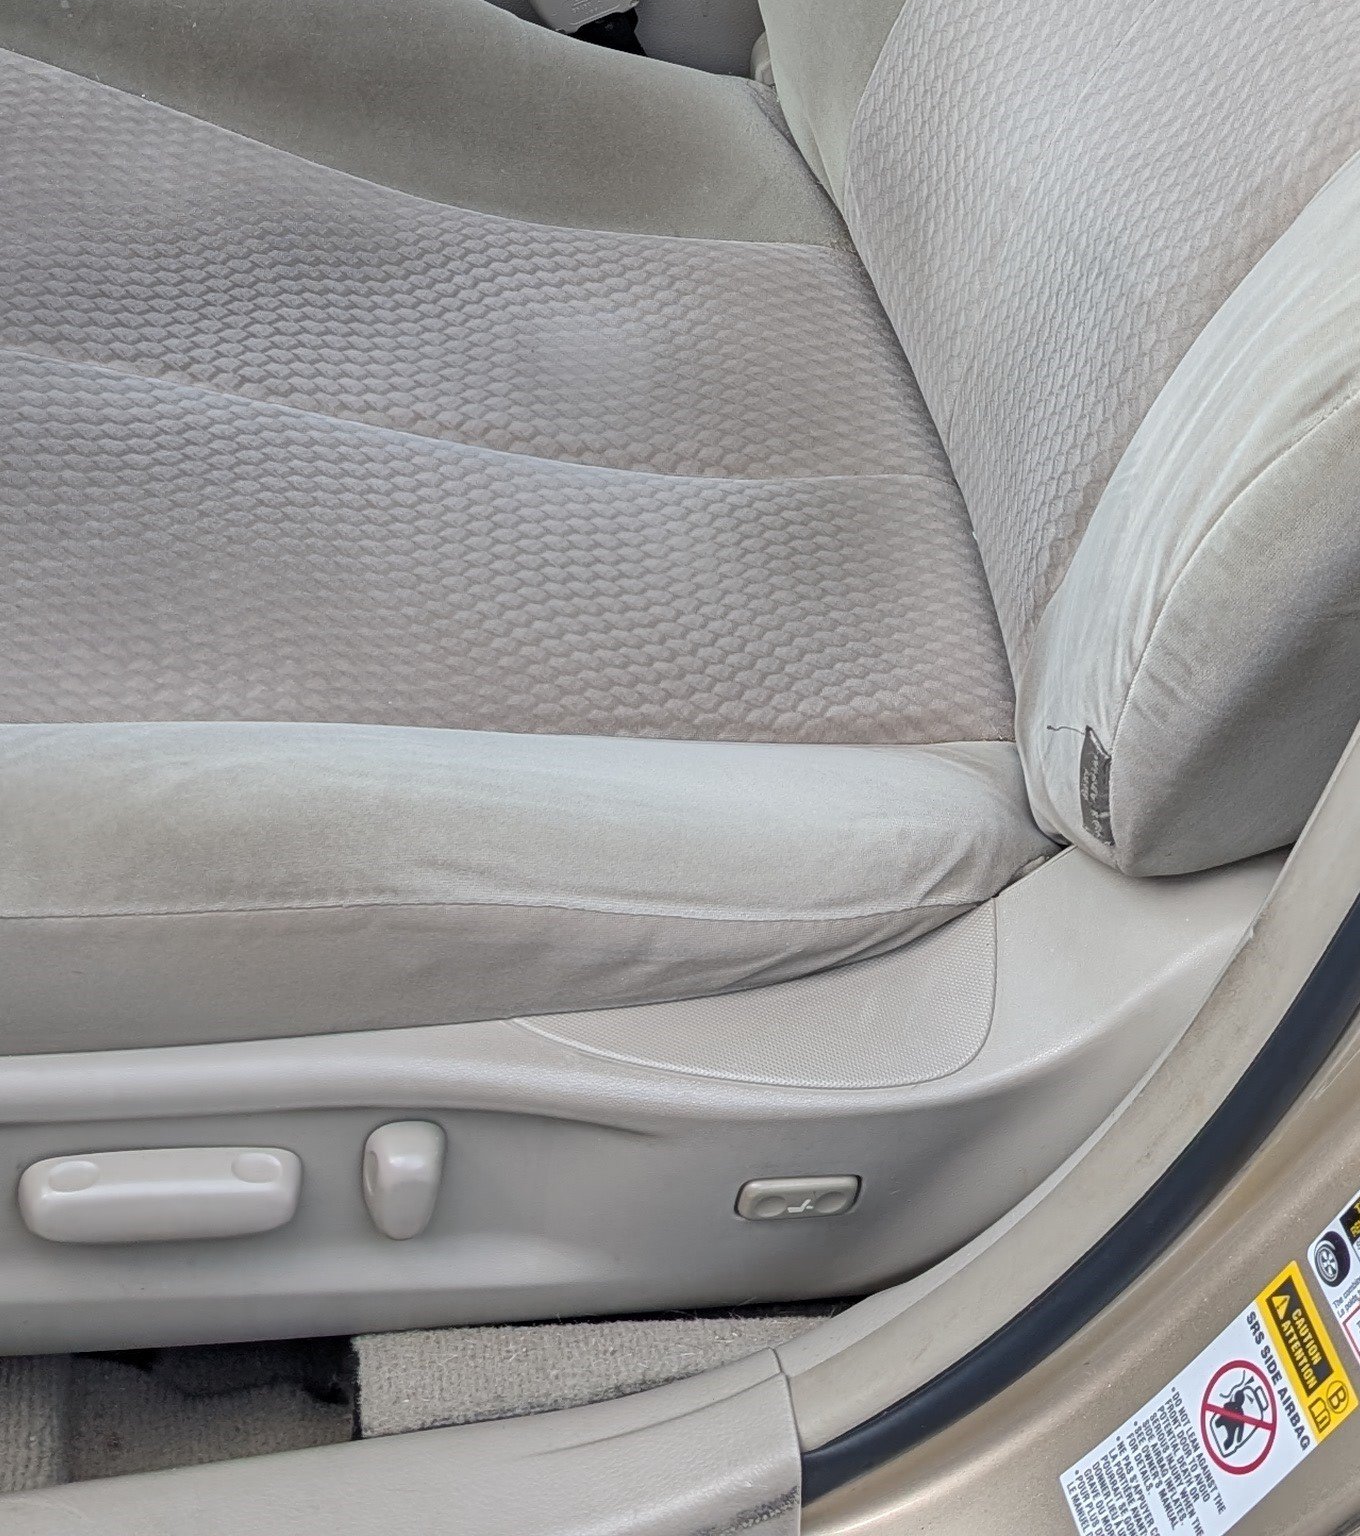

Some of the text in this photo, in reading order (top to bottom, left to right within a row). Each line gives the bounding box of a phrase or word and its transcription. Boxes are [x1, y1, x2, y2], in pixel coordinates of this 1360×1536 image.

[1279, 1317, 1318, 1390] ATTENTION
[1290, 1306, 1322, 1366] CAUTION
[1244, 1309, 1312, 1451] SRS SIDE AIRBAG
[1327, 1384, 1349, 1412] B
[1107, 1446, 1118, 1463] LA
[1115, 1439, 1127, 1458] NE
[1120, 1453, 1134, 1476] PAS
[1125, 1431, 1139, 1454] FOR
[1140, 1417, 1156, 1443] SIDE
[1149, 1439, 1169, 1478] AIRBAG
[1148, 1410, 1170, 1454] SERIOUS
[1164, 1450, 1184, 1489] INJURY
[1178, 1486, 1196, 1519] WHEN
[1156, 1404, 1200, 1503] POTENTIAL DEATH OR
[1163, 1397, 1211, 1504] FRONT DOOR TO AVOID
[1171, 1391, 1226, 1515] DO NOT LEAN AGAINST THE
[1066, 1479, 1090, 1534] LE MANUEL
[1074, 1473, 1099, 1529] POUR PLUS
[1082, 1466, 1106, 1516] GRAVE OU
[1091, 1460, 1111, 1501] DONNER
[1105, 1497, 1119, 1522] LIEU
[1099, 1453, 1123, 1503] POURRAIT
[1117, 1500, 1129, 1518] SE
[1133, 1424, 1180, 1531] SEE OWNER'S MANUAL
